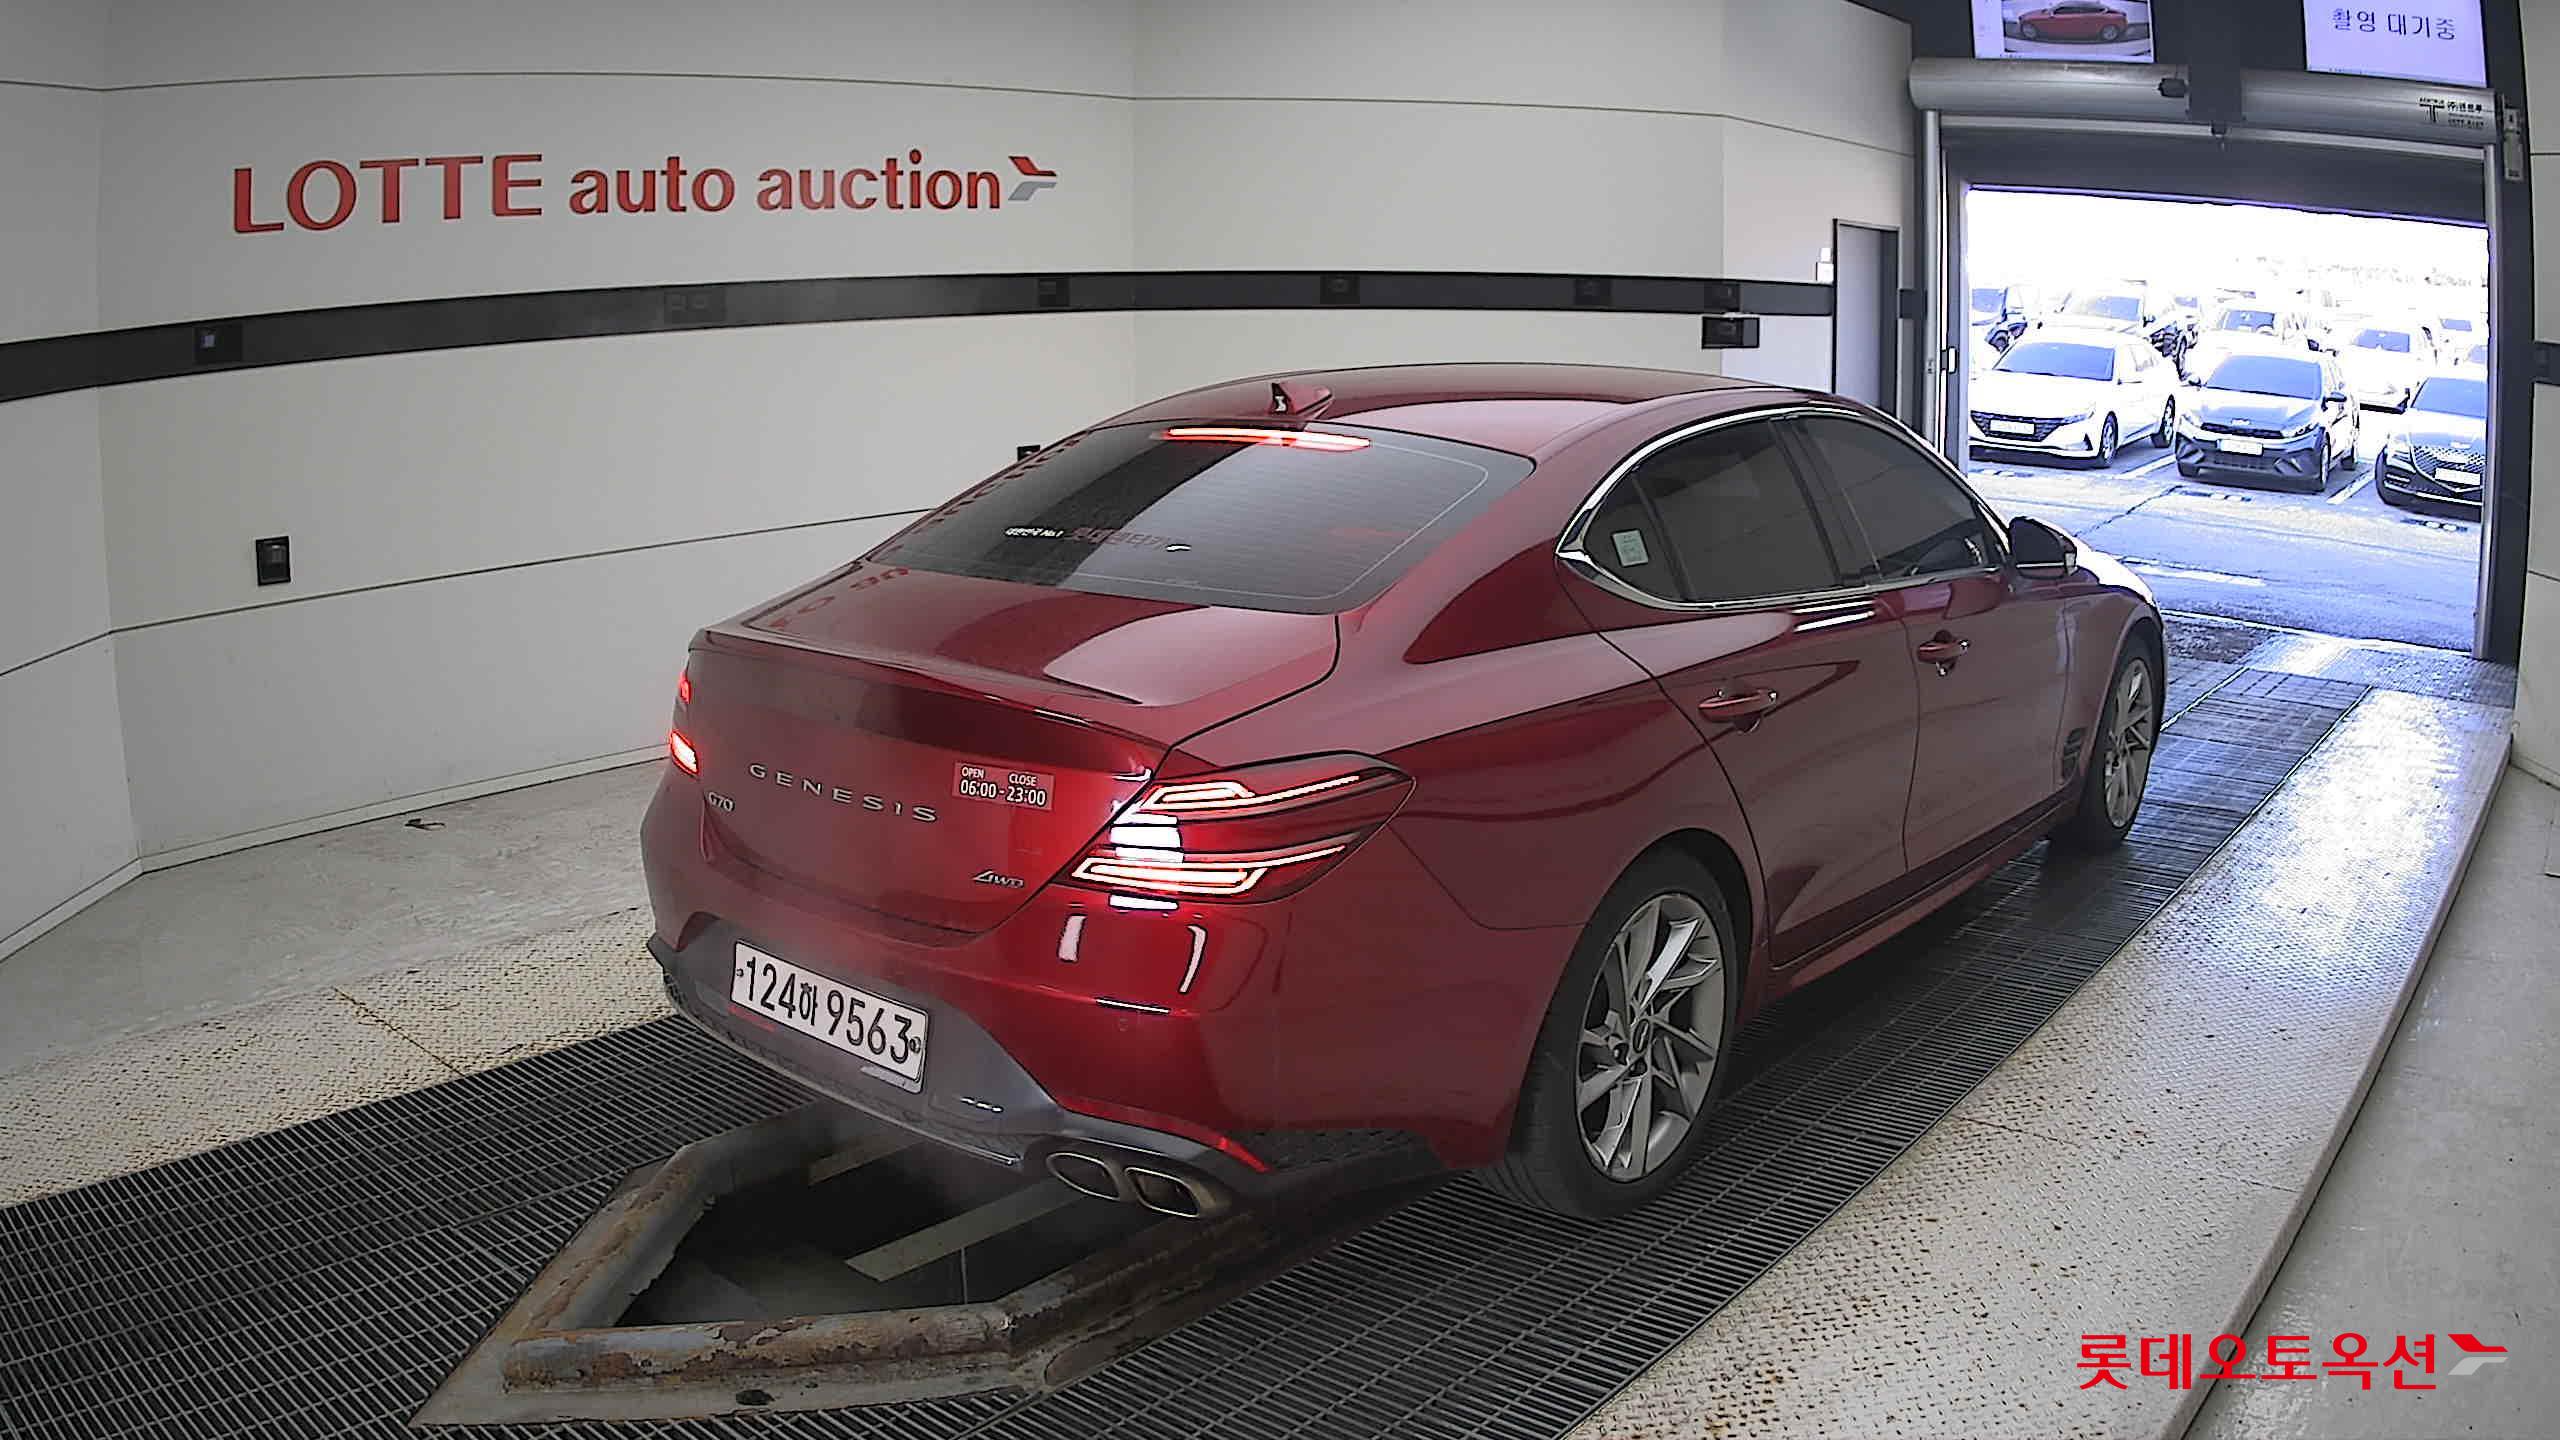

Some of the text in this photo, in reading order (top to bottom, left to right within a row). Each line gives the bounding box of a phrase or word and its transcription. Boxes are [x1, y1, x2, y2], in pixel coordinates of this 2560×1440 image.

[2332, 8, 2456, 40] 촬영 대기중
[233, 148, 1001, 234] LOTTE auto auction
[749, 763, 938, 822] GENESIS
[961, 766, 1037, 787] OPEN CLOSE
[707, 791, 735, 812] G70
[972, 870, 1024, 888] AWD
[746, 956, 912, 1064] 124하 9563
